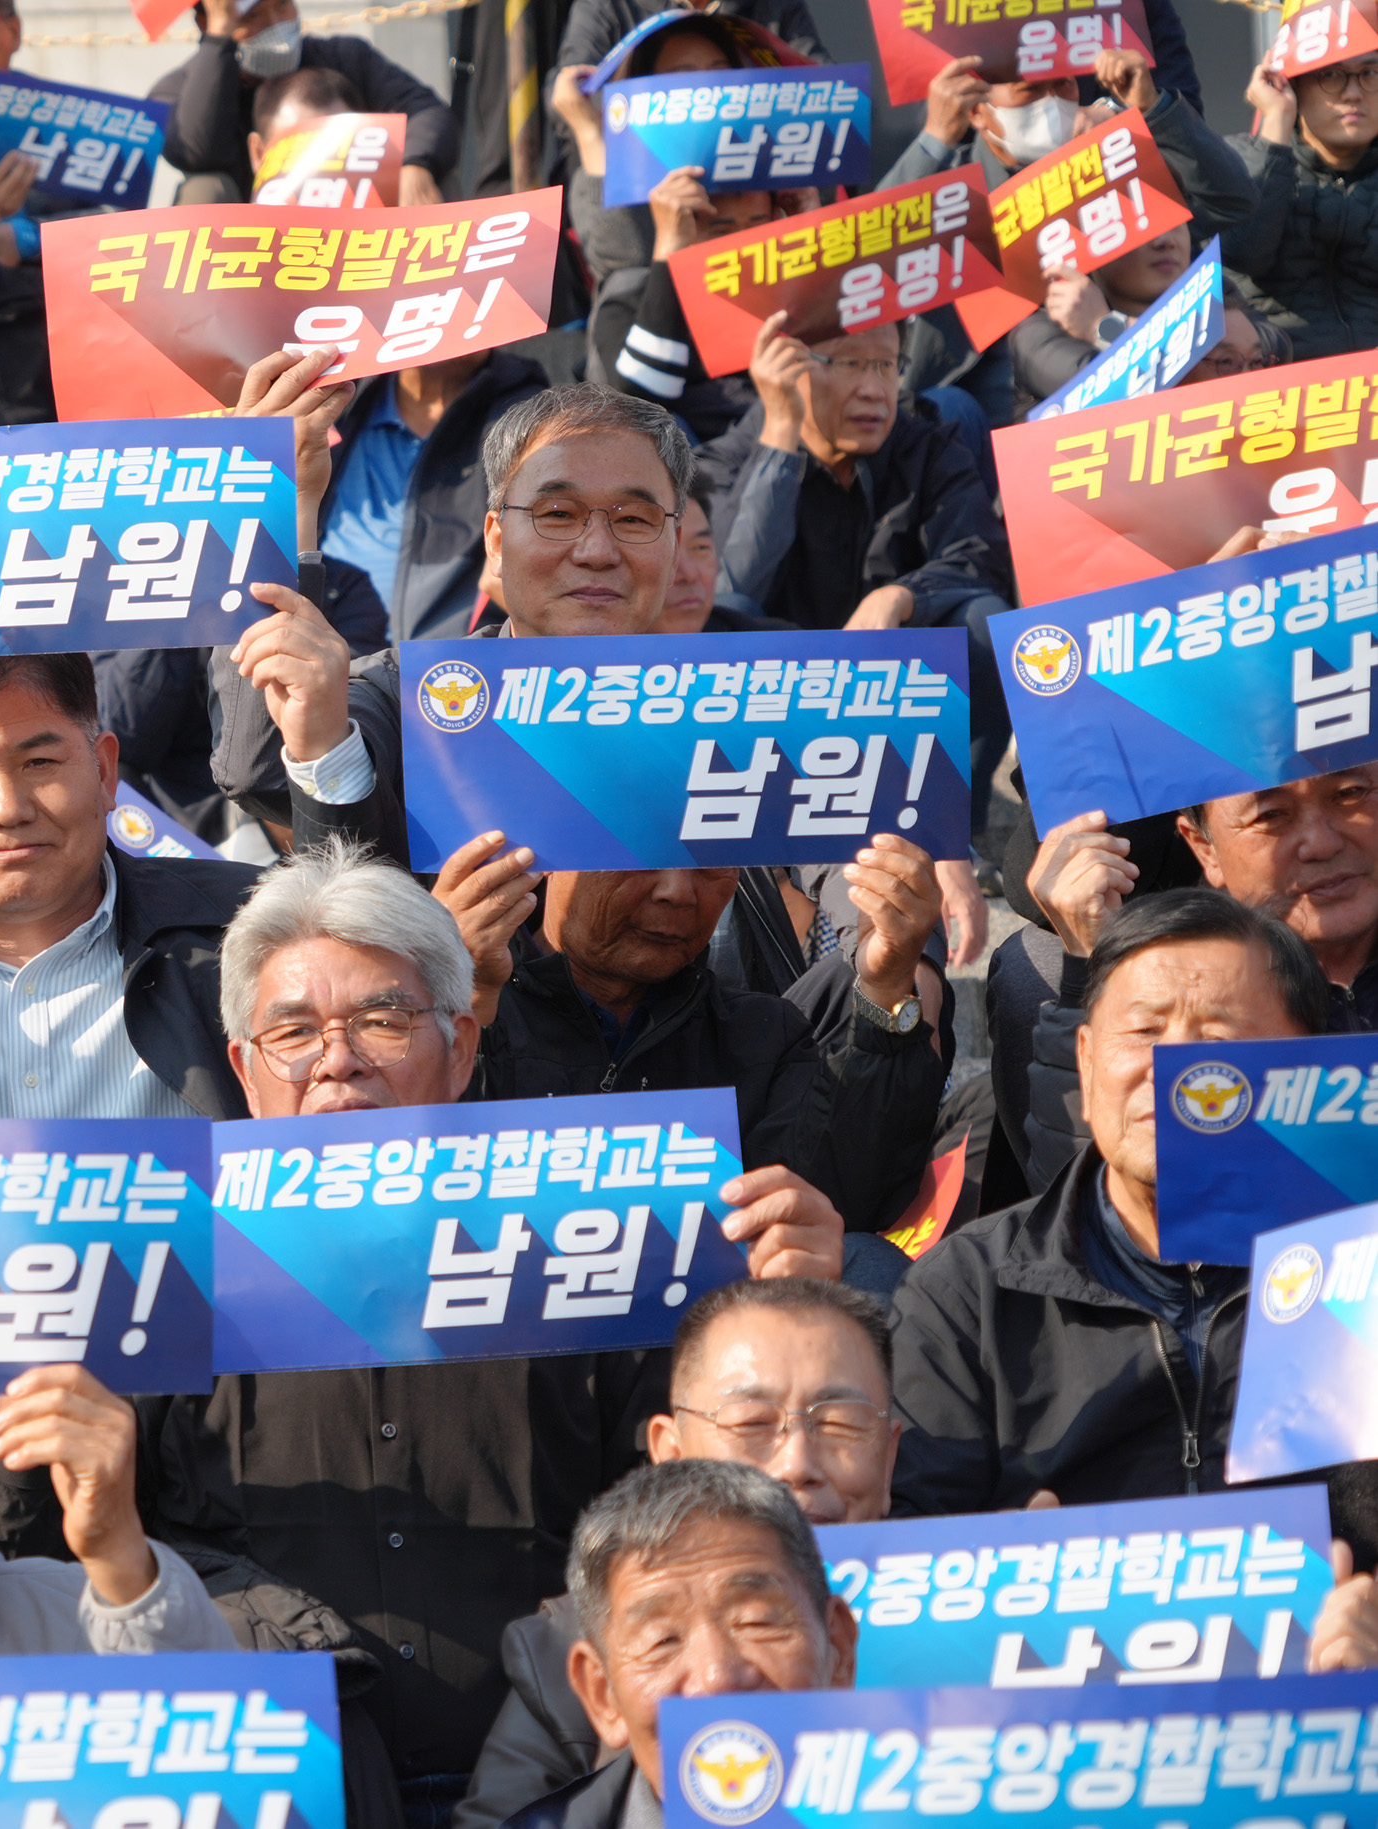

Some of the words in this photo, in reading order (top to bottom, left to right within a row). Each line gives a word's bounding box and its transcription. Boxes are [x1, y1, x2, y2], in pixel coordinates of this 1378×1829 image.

[627, 80, 858, 126] 제2중앙경찰학교는
[712, 119, 850, 181] 남원!
[90, 211, 530, 302] 국가균형발전은
[704, 181, 969, 296] 국가균형발전은
[838, 235, 965, 327] 운명!
[1049, 373, 1378, 500] 국가균형발
[492, 658, 947, 725] 제2중앙경찰학교는
[679, 733, 936, 840] 남원!
[1254, 1062, 1378, 1125] 제2
[212, 1122, 716, 1211] 제2중앙경찰학교는
[422, 1201, 705, 1330] 남원!
[784, 1706, 1378, 1815] 제2중앙경찰학교
